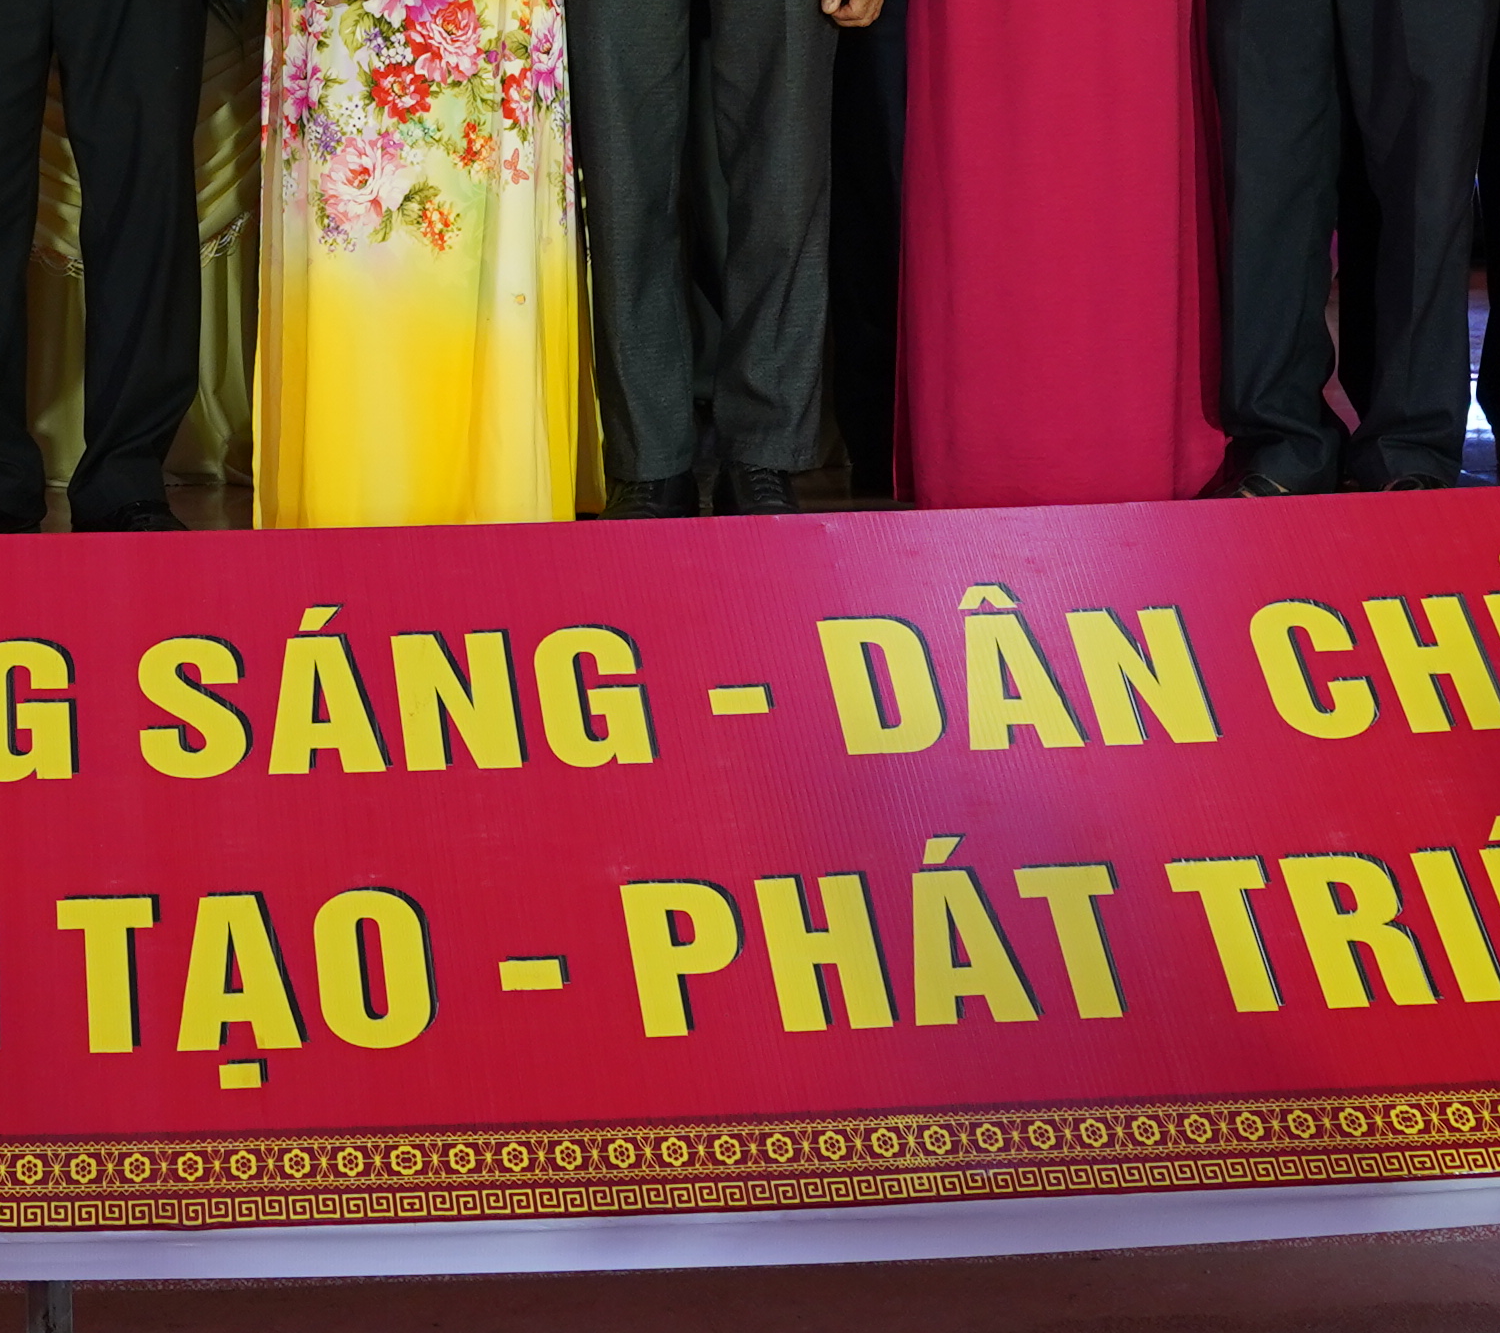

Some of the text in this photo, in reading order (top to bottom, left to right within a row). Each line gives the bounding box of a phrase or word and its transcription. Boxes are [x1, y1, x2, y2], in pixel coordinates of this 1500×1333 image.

[139, 605, 656, 780] SÁNG
[709, 687, 772, 716] -
[817, 586, 1219, 757] DÂN
[57, 890, 433, 1090] TẠO
[499, 957, 564, 992] -
[620, 836, 1124, 1039] PHÁT
